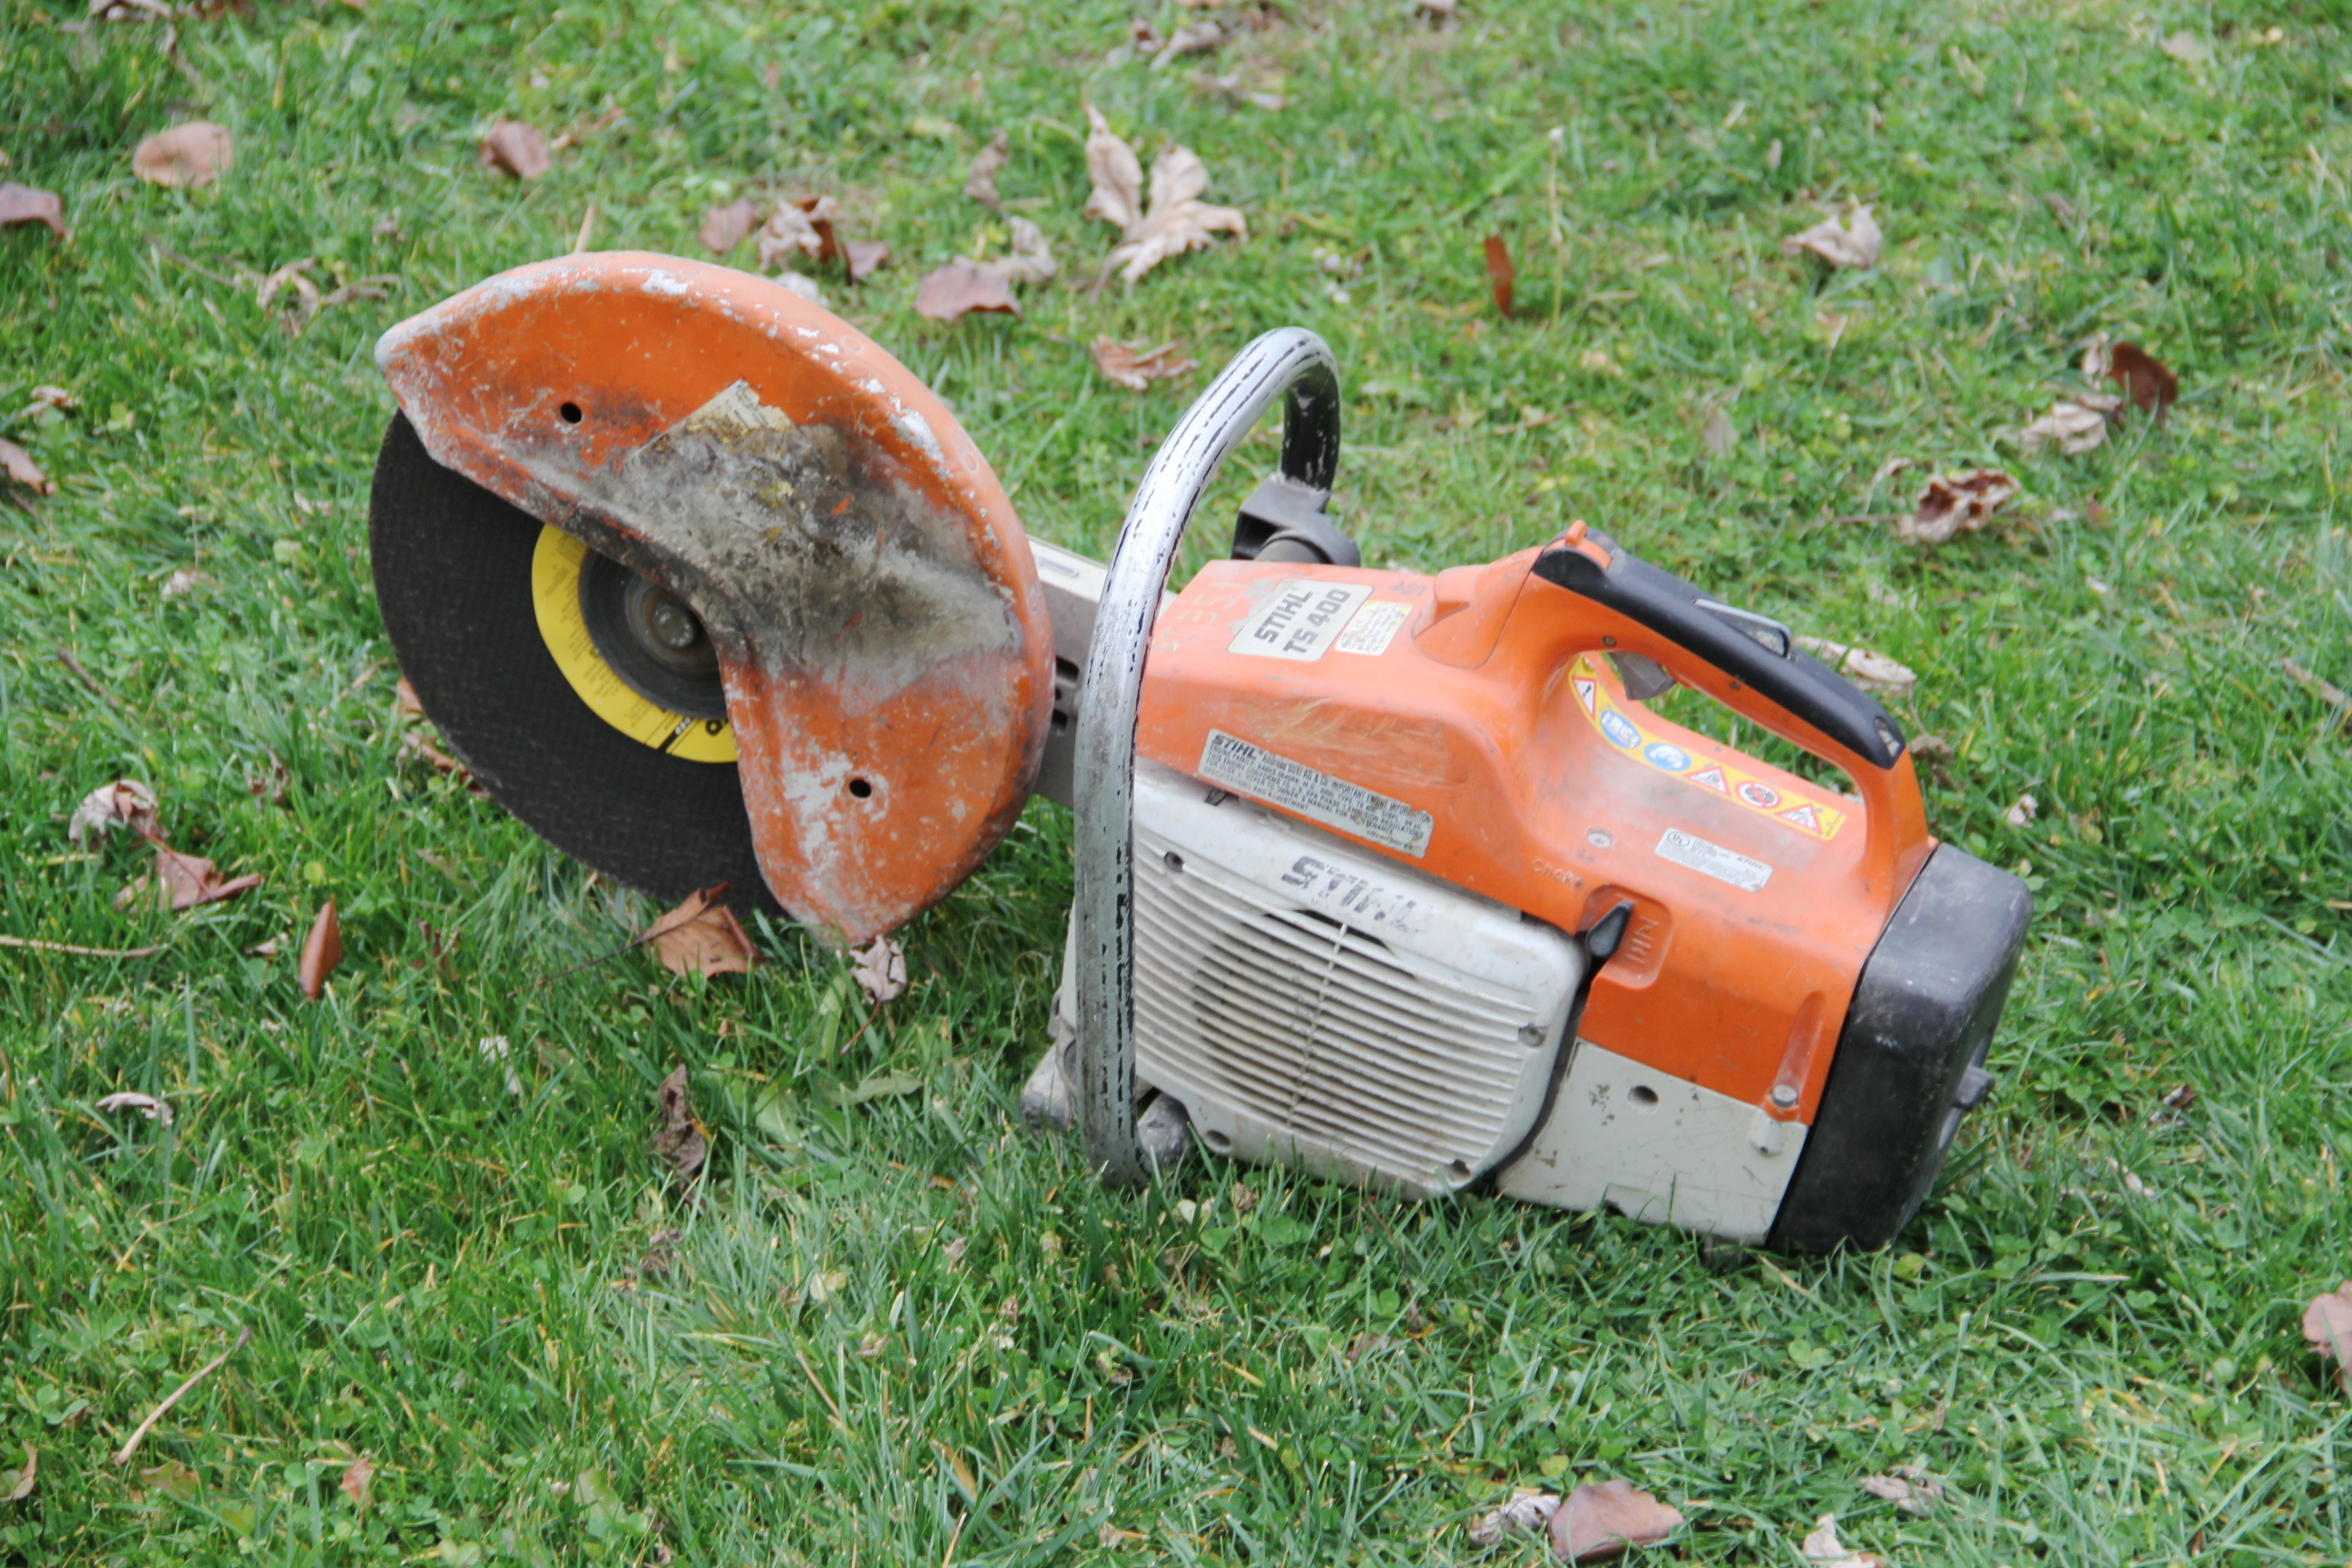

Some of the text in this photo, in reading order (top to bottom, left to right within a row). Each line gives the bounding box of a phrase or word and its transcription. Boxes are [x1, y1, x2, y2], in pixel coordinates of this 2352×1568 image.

[1253, 591, 1314, 643] STIHL
[1282, 589, 1351, 653] TS 400
[1212, 732, 1259, 760] STIHL
[1331, 779, 1365, 799] IMPORTANT
[1389, 801, 1431, 824] INFORMTION
[1269, 790, 1308, 812] AJUSTMENT
